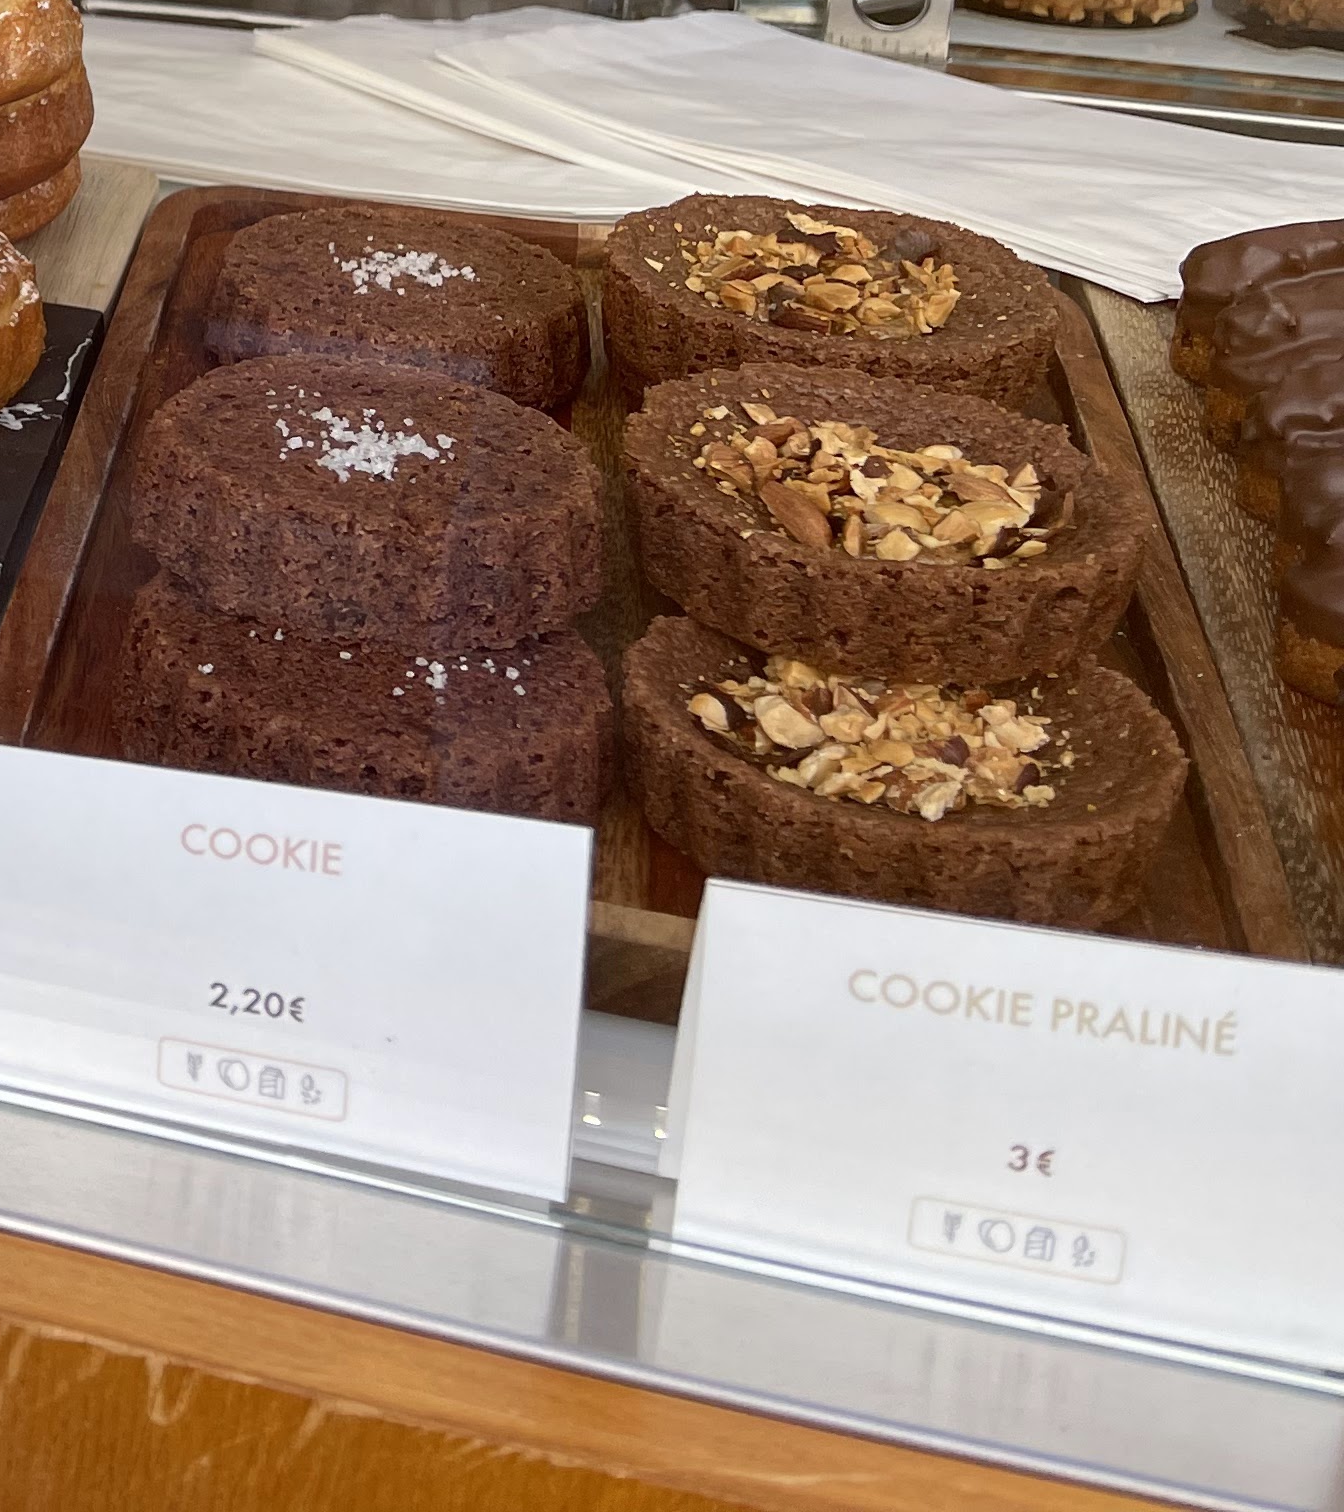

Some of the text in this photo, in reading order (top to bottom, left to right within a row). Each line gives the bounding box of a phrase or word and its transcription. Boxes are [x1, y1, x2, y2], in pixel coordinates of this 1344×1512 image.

[179, 823, 343, 877] COOKIE
[209, 982, 305, 1023] 2,20€
[847, 968, 1239, 1057] COOKIE PRALINÉ
